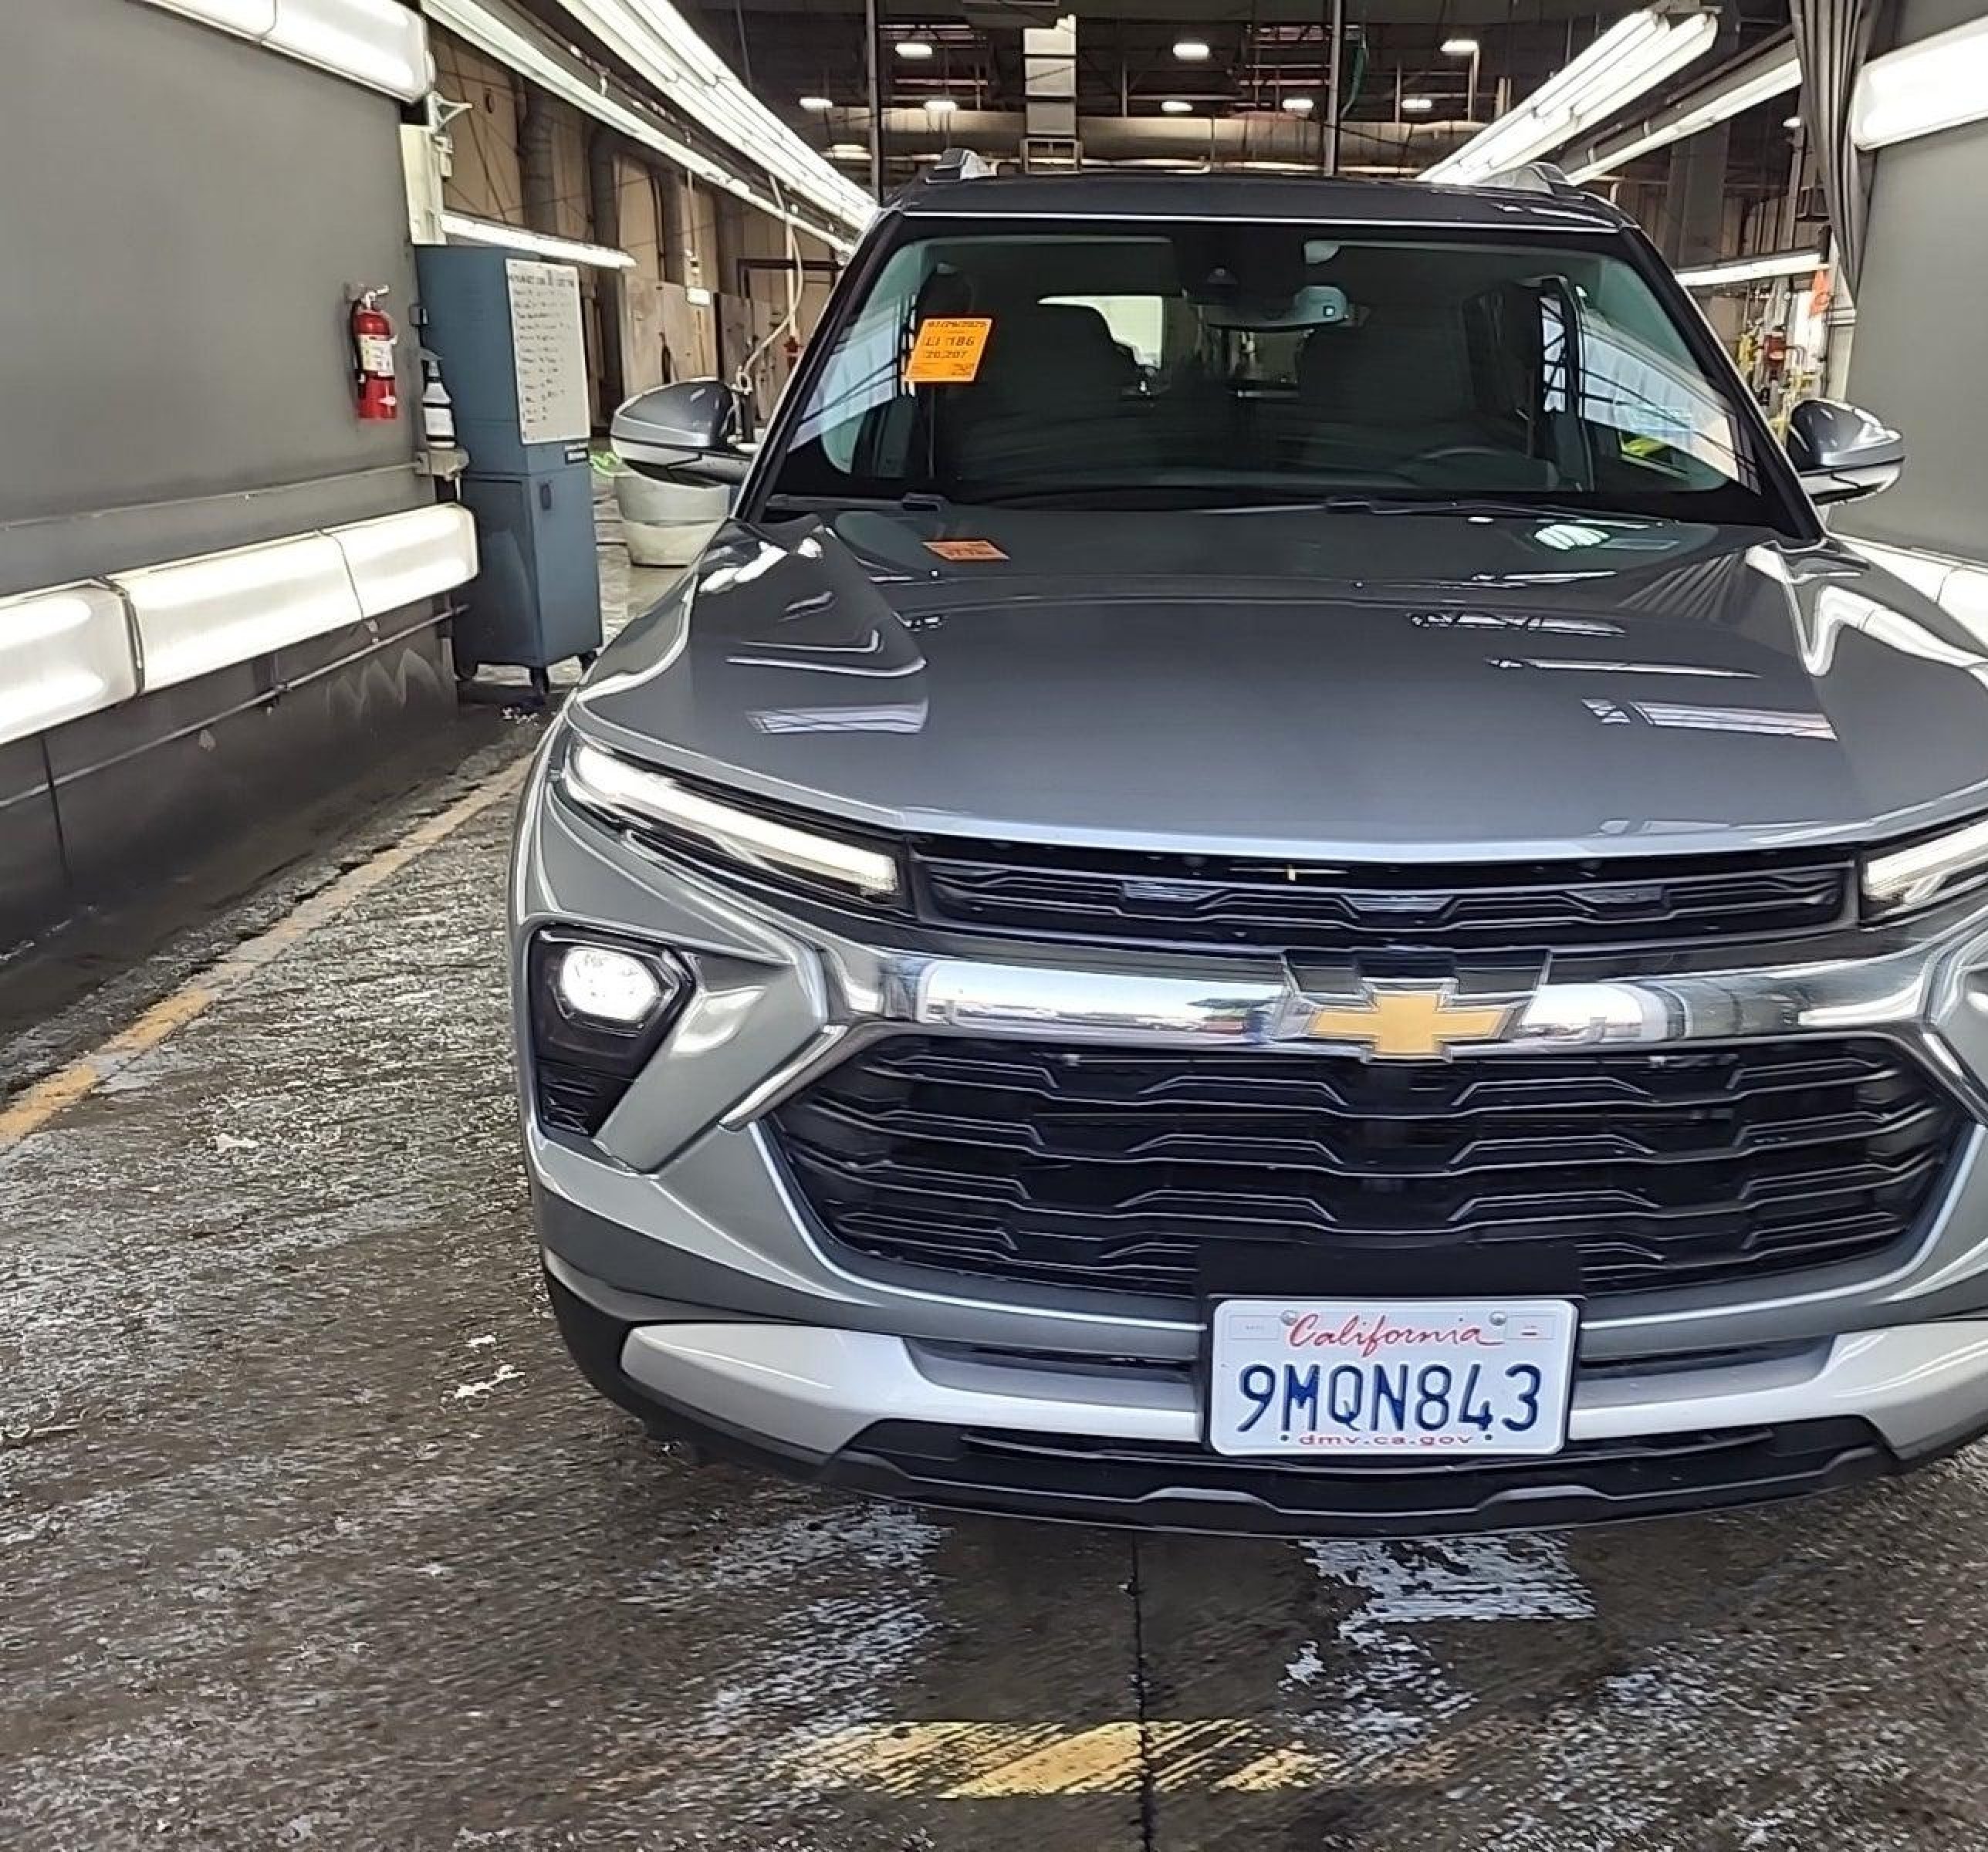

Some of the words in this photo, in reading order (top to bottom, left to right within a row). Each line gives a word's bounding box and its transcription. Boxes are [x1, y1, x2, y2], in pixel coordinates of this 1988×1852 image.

[1288, 1312, 1506, 1357] California
[1236, 1364, 1543, 1432] 9MQN843
[1298, 1433, 1474, 1447] dmv.ca.gov
